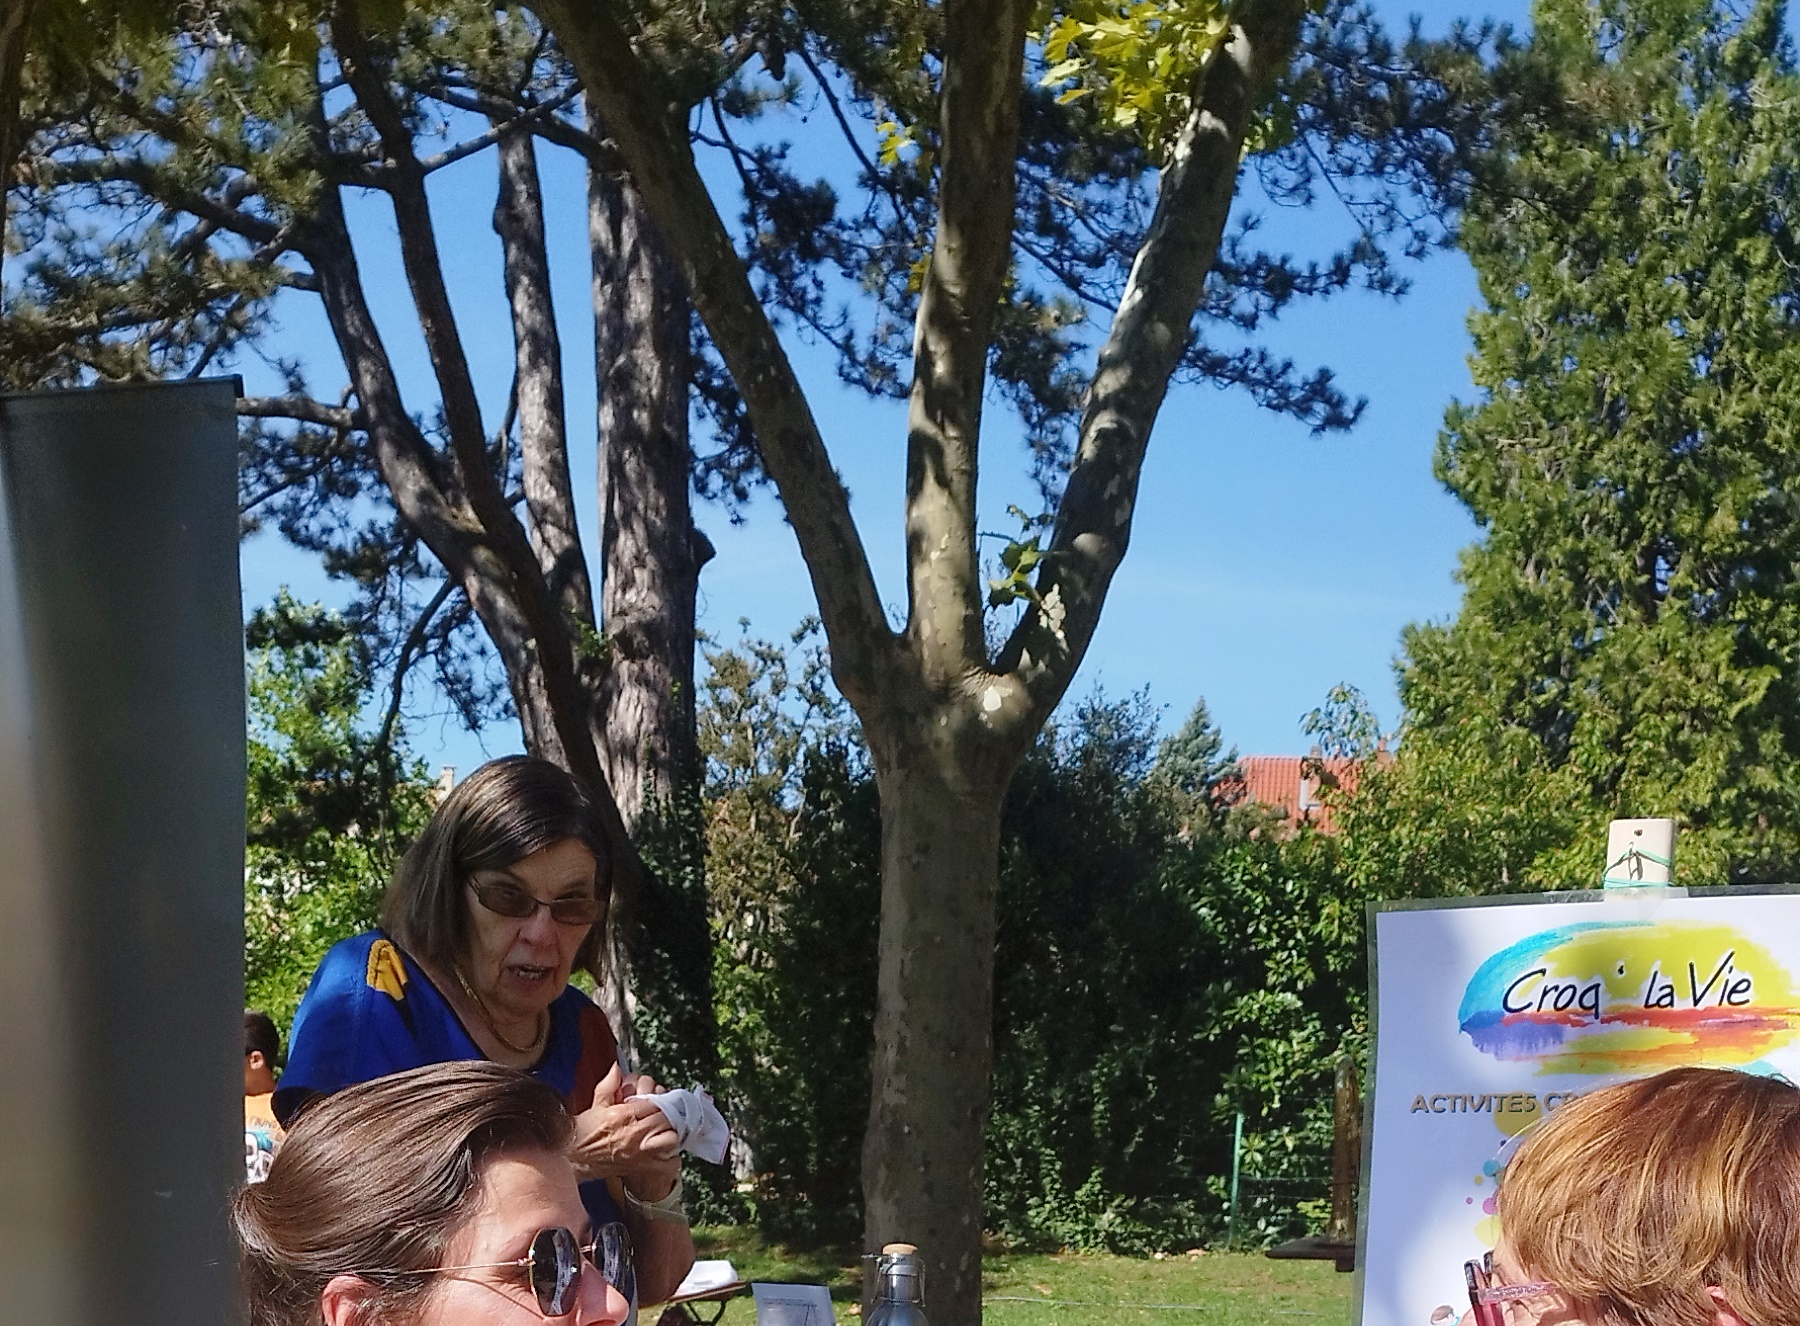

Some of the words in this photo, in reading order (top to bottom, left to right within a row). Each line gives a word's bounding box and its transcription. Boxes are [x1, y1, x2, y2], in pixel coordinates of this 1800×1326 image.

[1643, 970, 1675, 1010] la
[1689, 949, 1753, 1008] Vie
[1410, 1092, 1537, 1114] ACTIVITES
